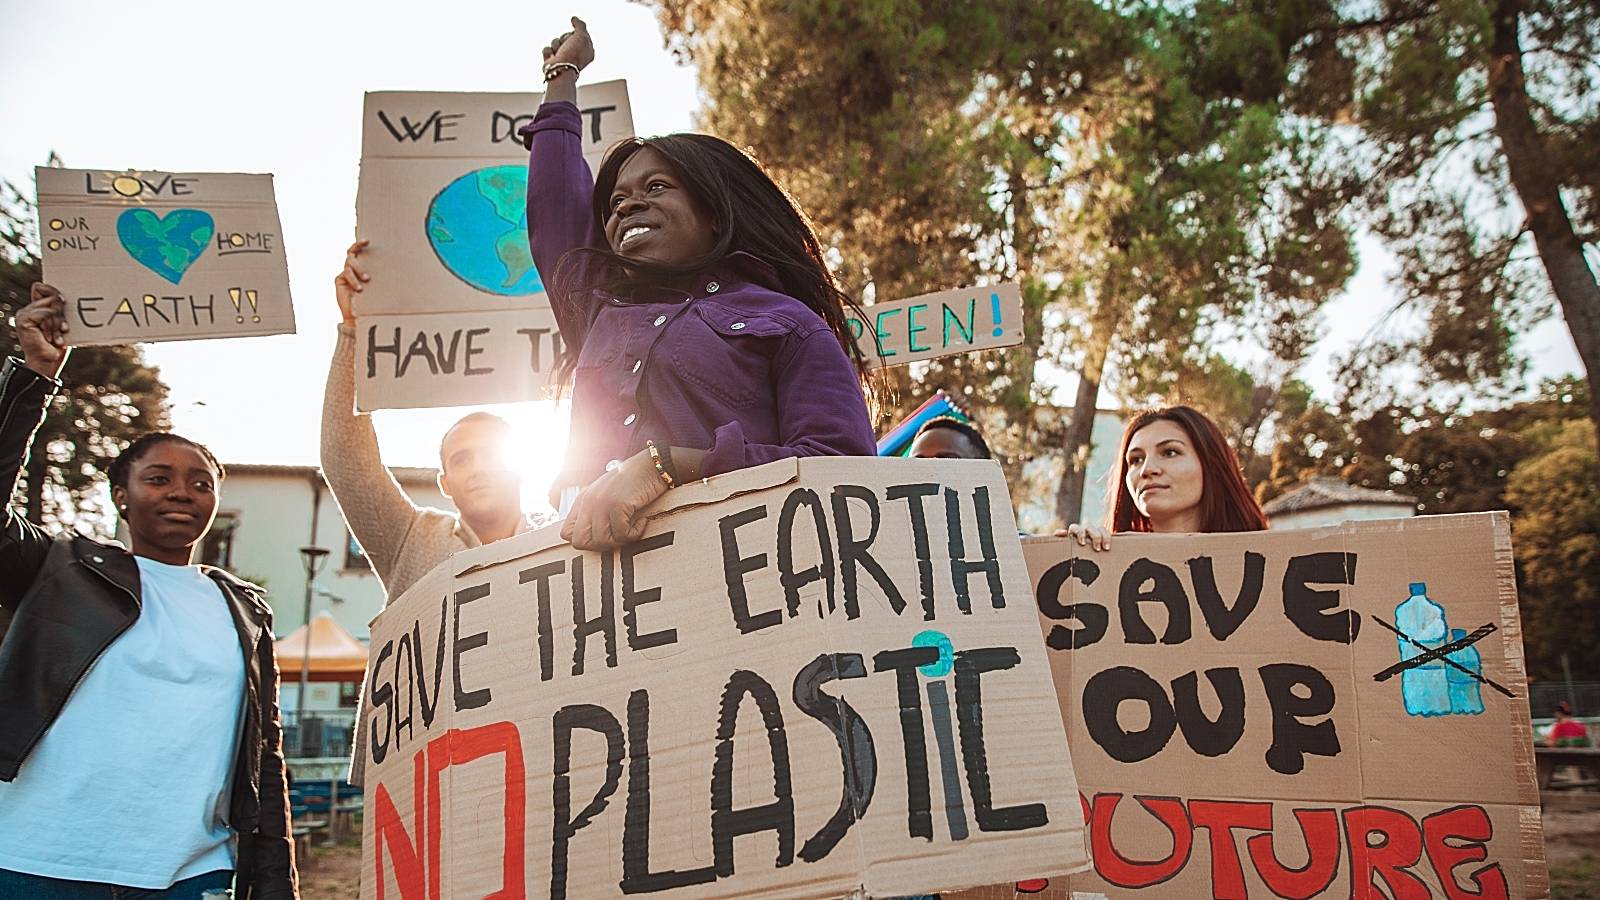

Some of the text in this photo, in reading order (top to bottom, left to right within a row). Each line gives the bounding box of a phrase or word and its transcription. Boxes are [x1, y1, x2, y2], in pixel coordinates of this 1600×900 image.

[377, 109, 465, 143] WE
[86, 172, 199, 197] LOVE
[47, 236, 101, 251] ONLY
[50, 217, 90, 231] OUR
[217, 232, 275, 250] HOME
[76, 294, 215, 328] EARTH
[846, 292, 1004, 357] REEN!
[367, 323, 494, 379] HAVE
[371, 483, 1006, 765] SAVE THE EARTH
[1036, 551, 1362, 650] SAVE
[1082, 662, 1341, 775] OUR
[375, 720, 526, 900] NO
[1016, 792, 1511, 900] UTURE
